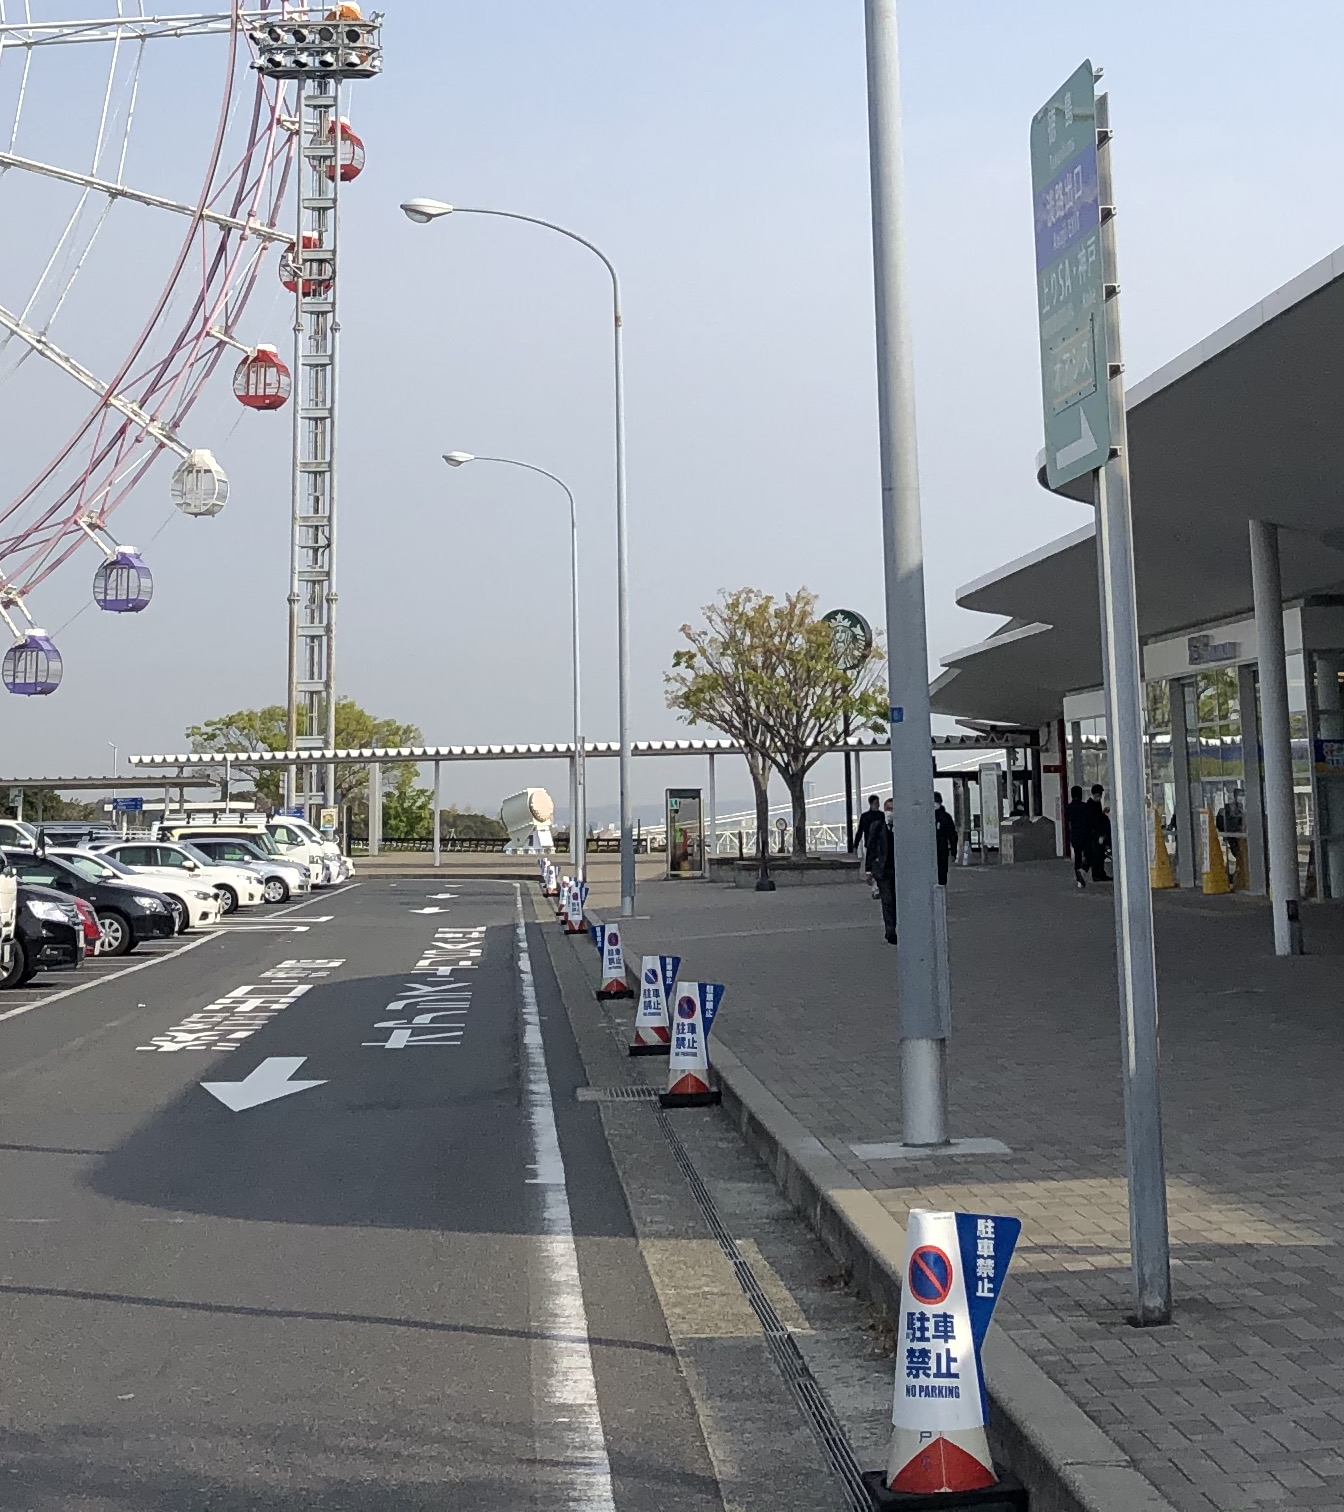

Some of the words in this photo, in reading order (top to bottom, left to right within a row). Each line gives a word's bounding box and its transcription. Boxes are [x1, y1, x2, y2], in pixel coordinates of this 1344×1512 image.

[976, 1218, 996, 1298] 駐車禁止
[906, 1311, 956, 1344] 駐車
[906, 1347, 960, 1380] 禁止
[905, 1384, 917, 1398] NO
[918, 1384, 961, 1399] PARKING
